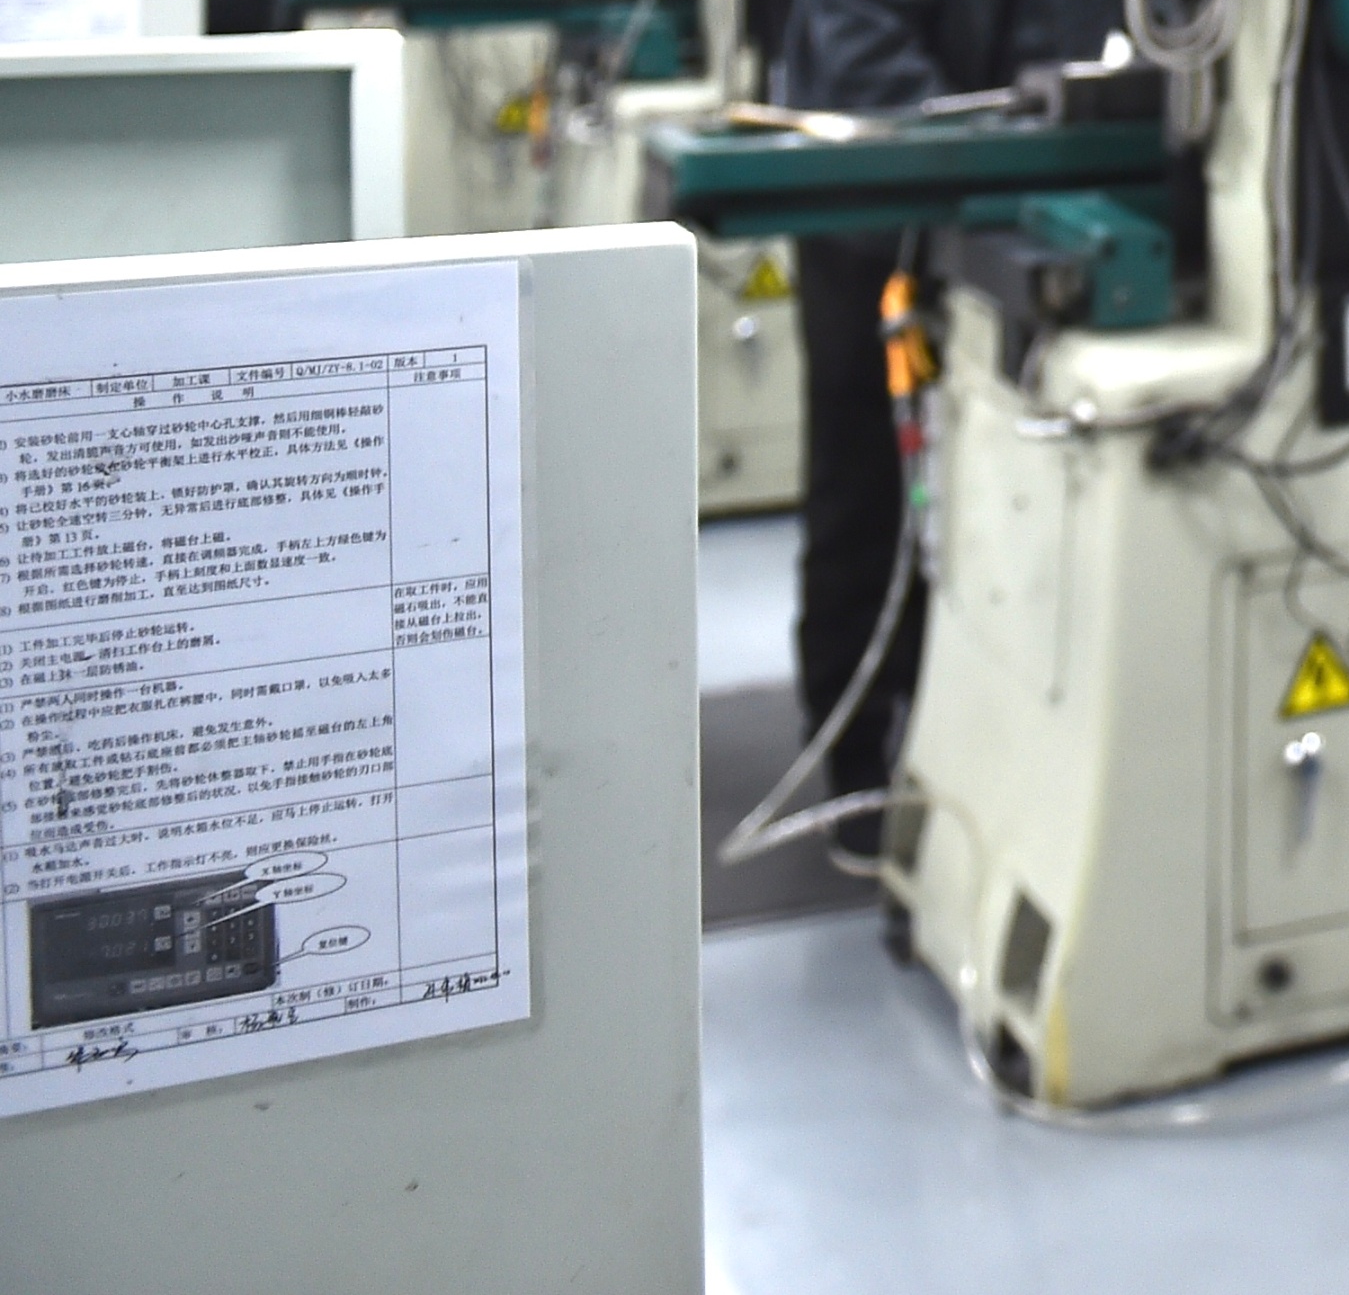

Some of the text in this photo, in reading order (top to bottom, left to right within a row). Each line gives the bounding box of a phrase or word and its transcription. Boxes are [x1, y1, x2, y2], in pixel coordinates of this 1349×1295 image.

[394, 355, 417, 367] 版本
[173, 373, 210, 387] 加工课
[236, 366, 284, 381] 文件编号
[413, 368, 460, 382] 注意事项
[96, 378, 147, 394] 制定单位
